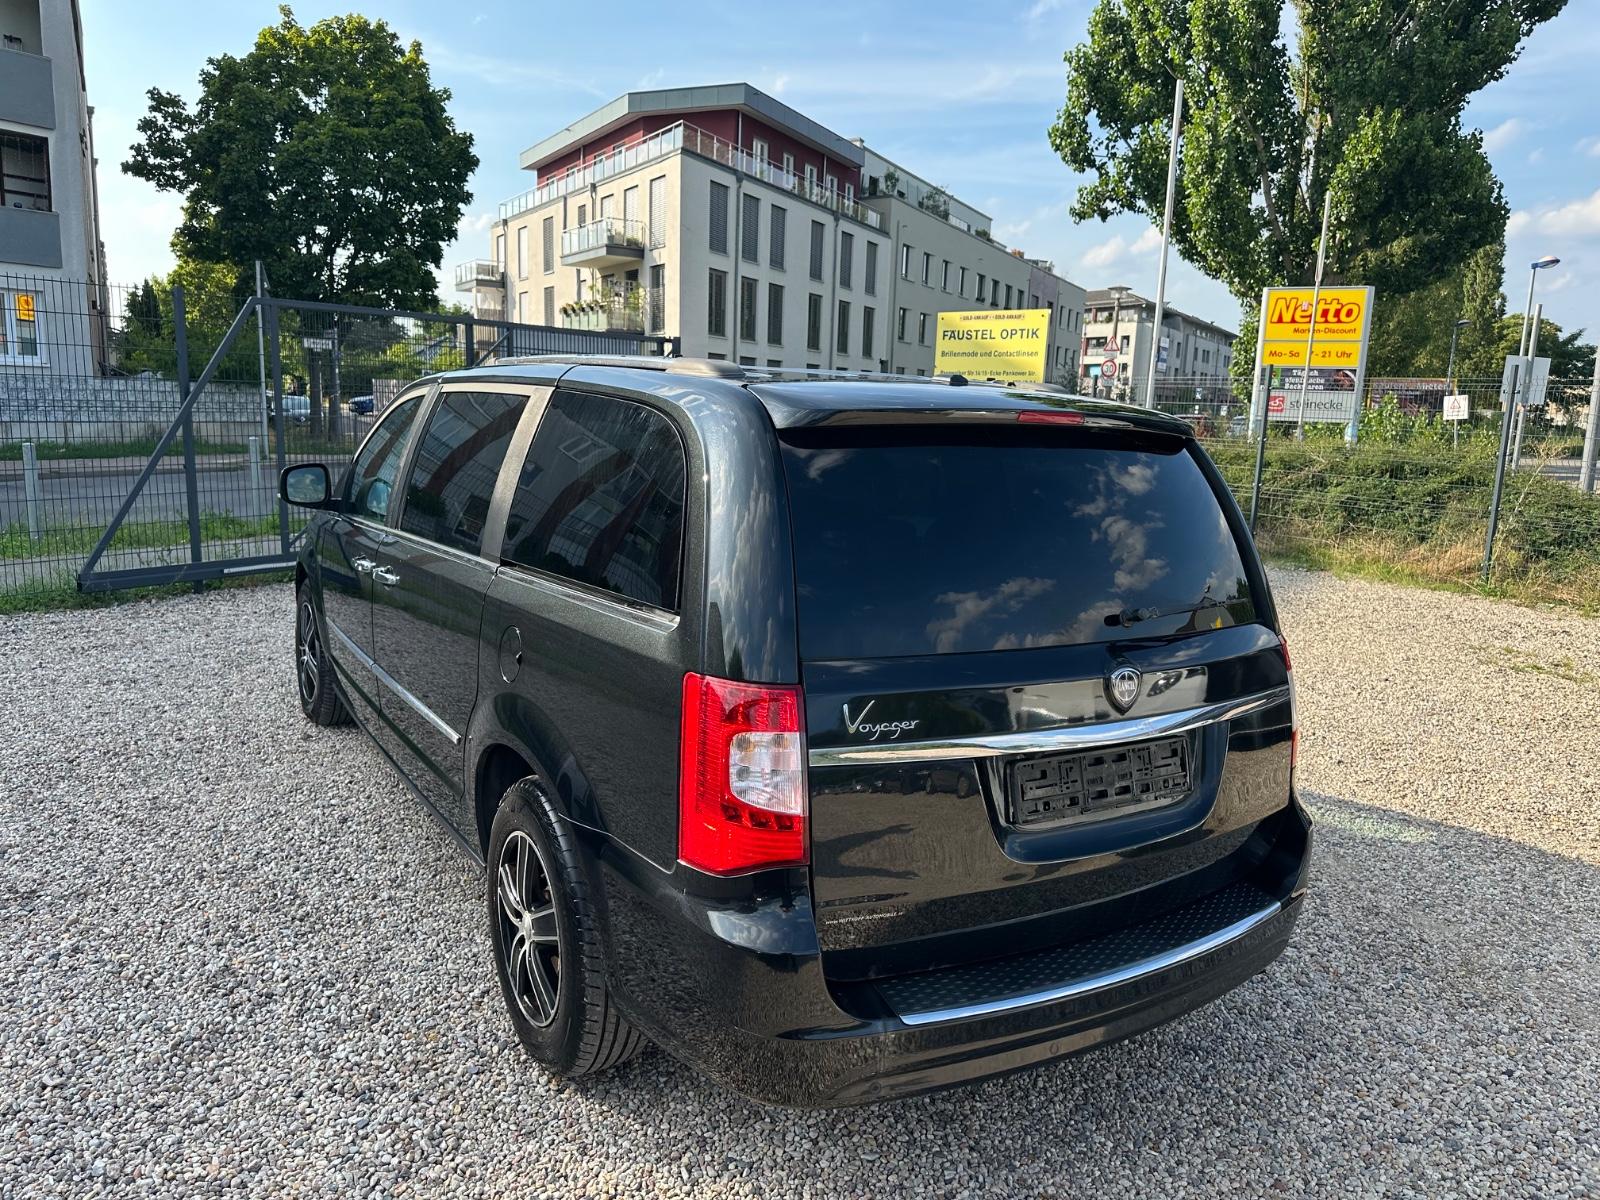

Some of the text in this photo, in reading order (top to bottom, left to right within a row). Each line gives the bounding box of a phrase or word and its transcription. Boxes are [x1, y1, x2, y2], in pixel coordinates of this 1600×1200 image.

[1270, 297, 1361, 323] Netto
[942, 328, 1040, 341] FÄUSTEL OPTIK
[941, 350, 979, 358] Brillenmode
[993, 349, 1039, 357] Contactlinsen
[1335, 351, 1353, 359] Uhr
[1105, 364, 1114, 373] 30
[1292, 369, 1319, 377] Tägch
[1284, 376, 1326, 384] ofenfsche
[842, 699, 920, 741] Voyager
